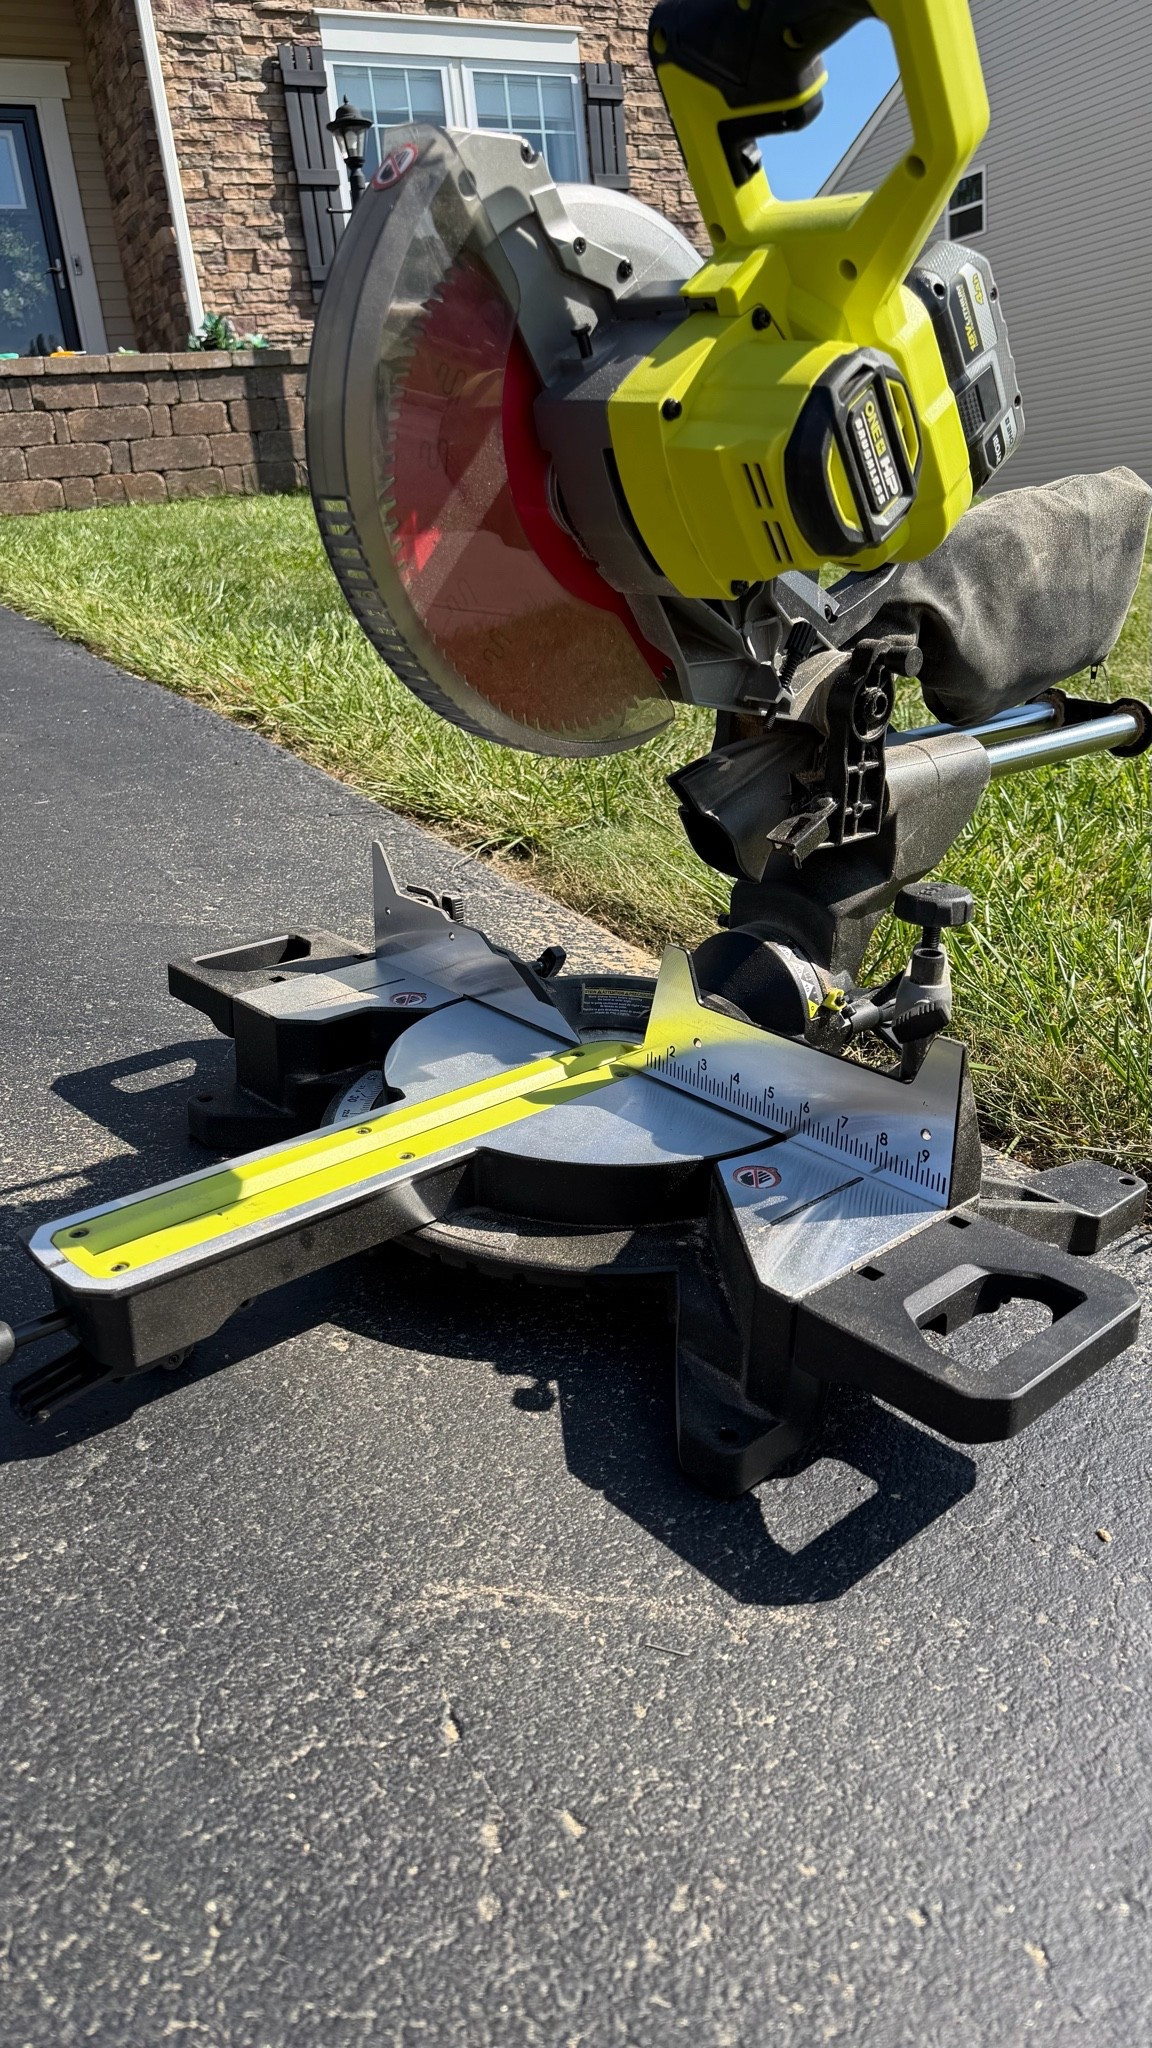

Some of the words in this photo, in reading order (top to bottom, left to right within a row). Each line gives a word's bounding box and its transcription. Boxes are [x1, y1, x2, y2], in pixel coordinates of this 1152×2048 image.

[956, 283, 970, 325] LITHIUM
[855, 417, 886, 505] BRUSHLESS
[880, 455, 899, 495] HP
[669, 1045, 676, 1058] 2
[700, 1058, 707, 1071] 3
[732, 1072, 740, 1084] 4
[767, 1086, 775, 1099] 5
[803, 1101, 810, 1114] 6
[841, 1115, 849, 1128] 7
[880, 1132, 888, 1146] 8
[922, 1149, 930, 1163] 9
